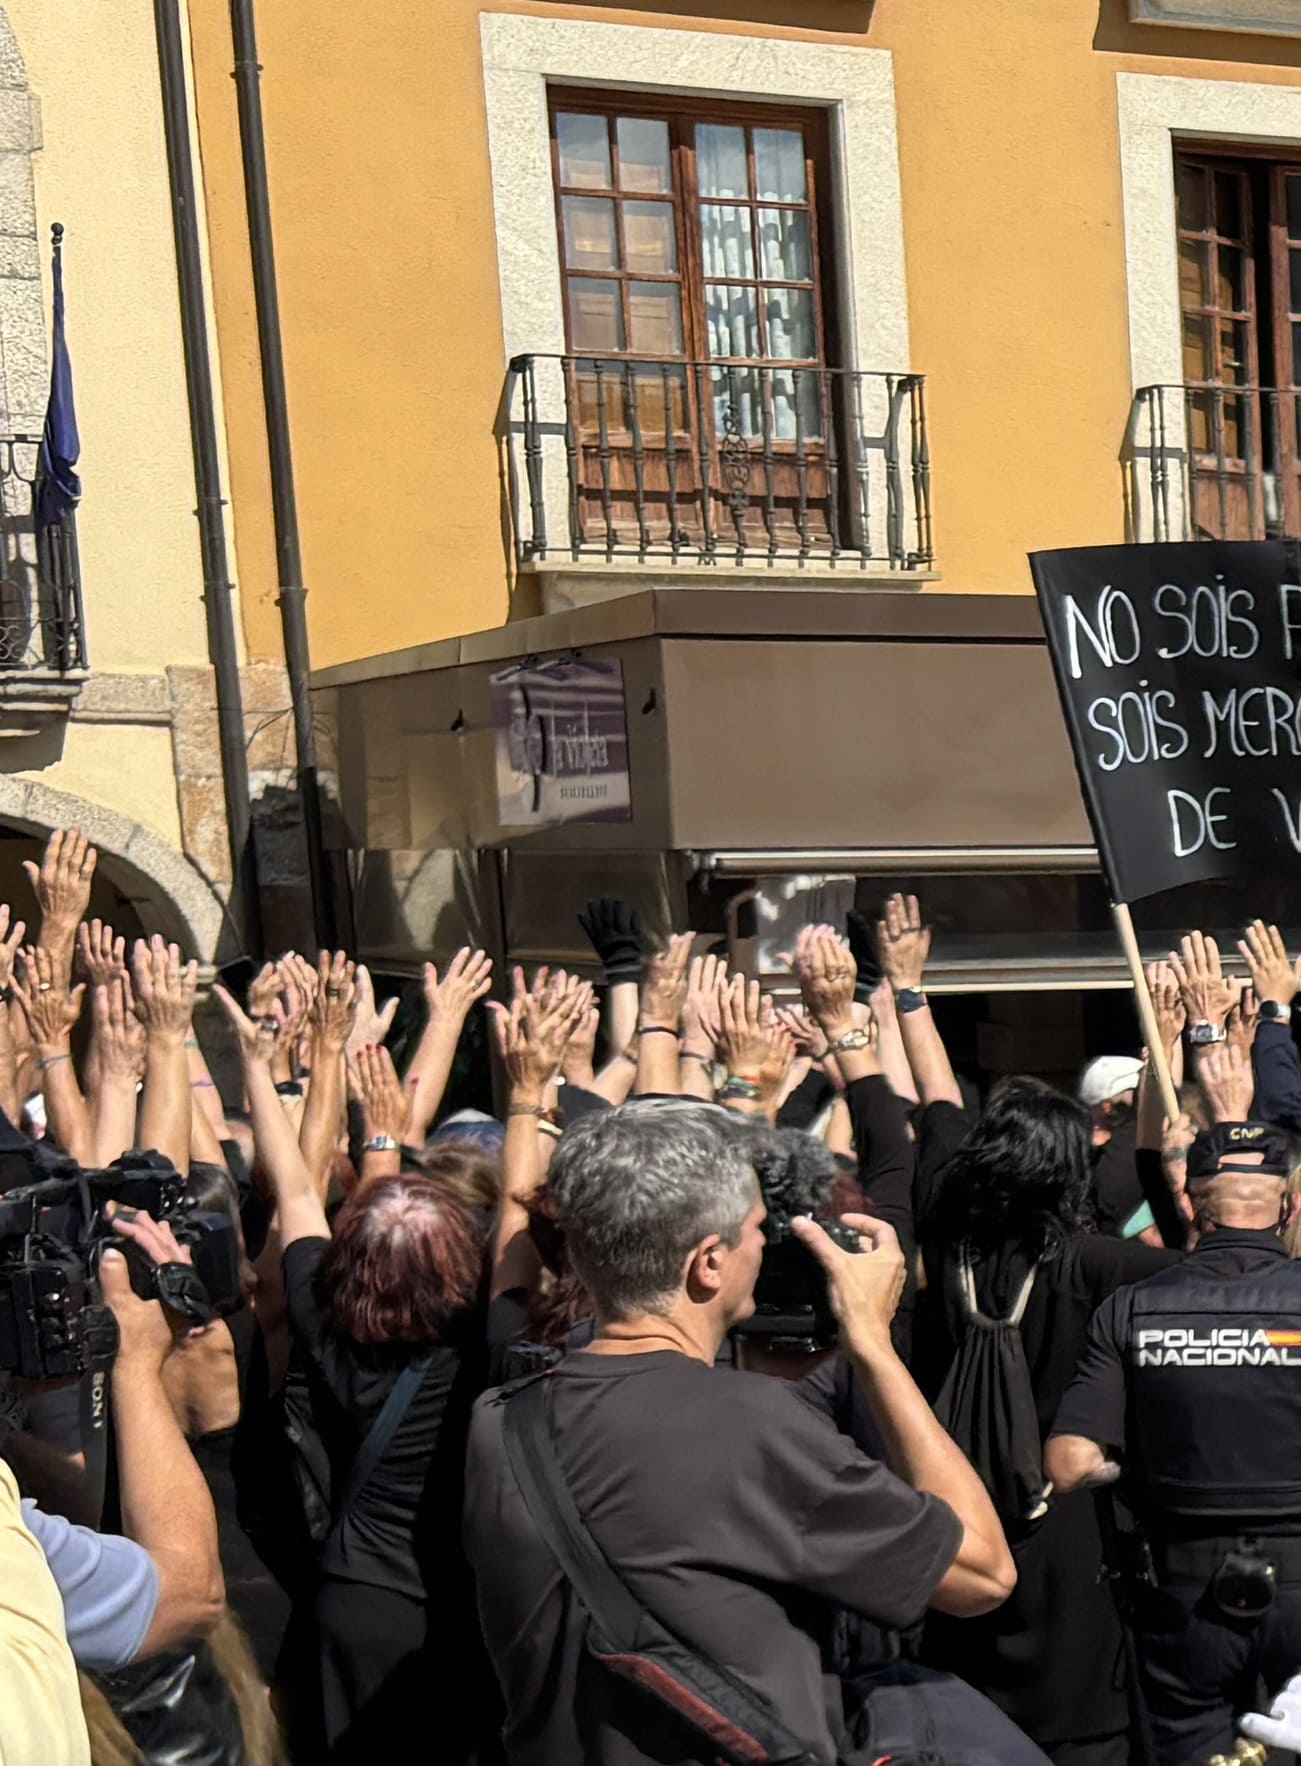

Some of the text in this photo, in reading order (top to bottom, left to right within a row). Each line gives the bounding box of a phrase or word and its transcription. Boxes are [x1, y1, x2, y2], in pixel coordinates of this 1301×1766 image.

[1066, 584, 1141, 680] NO
[1167, 786, 1238, 858] DE
[1138, 1328, 1271, 1348] POLICIA
